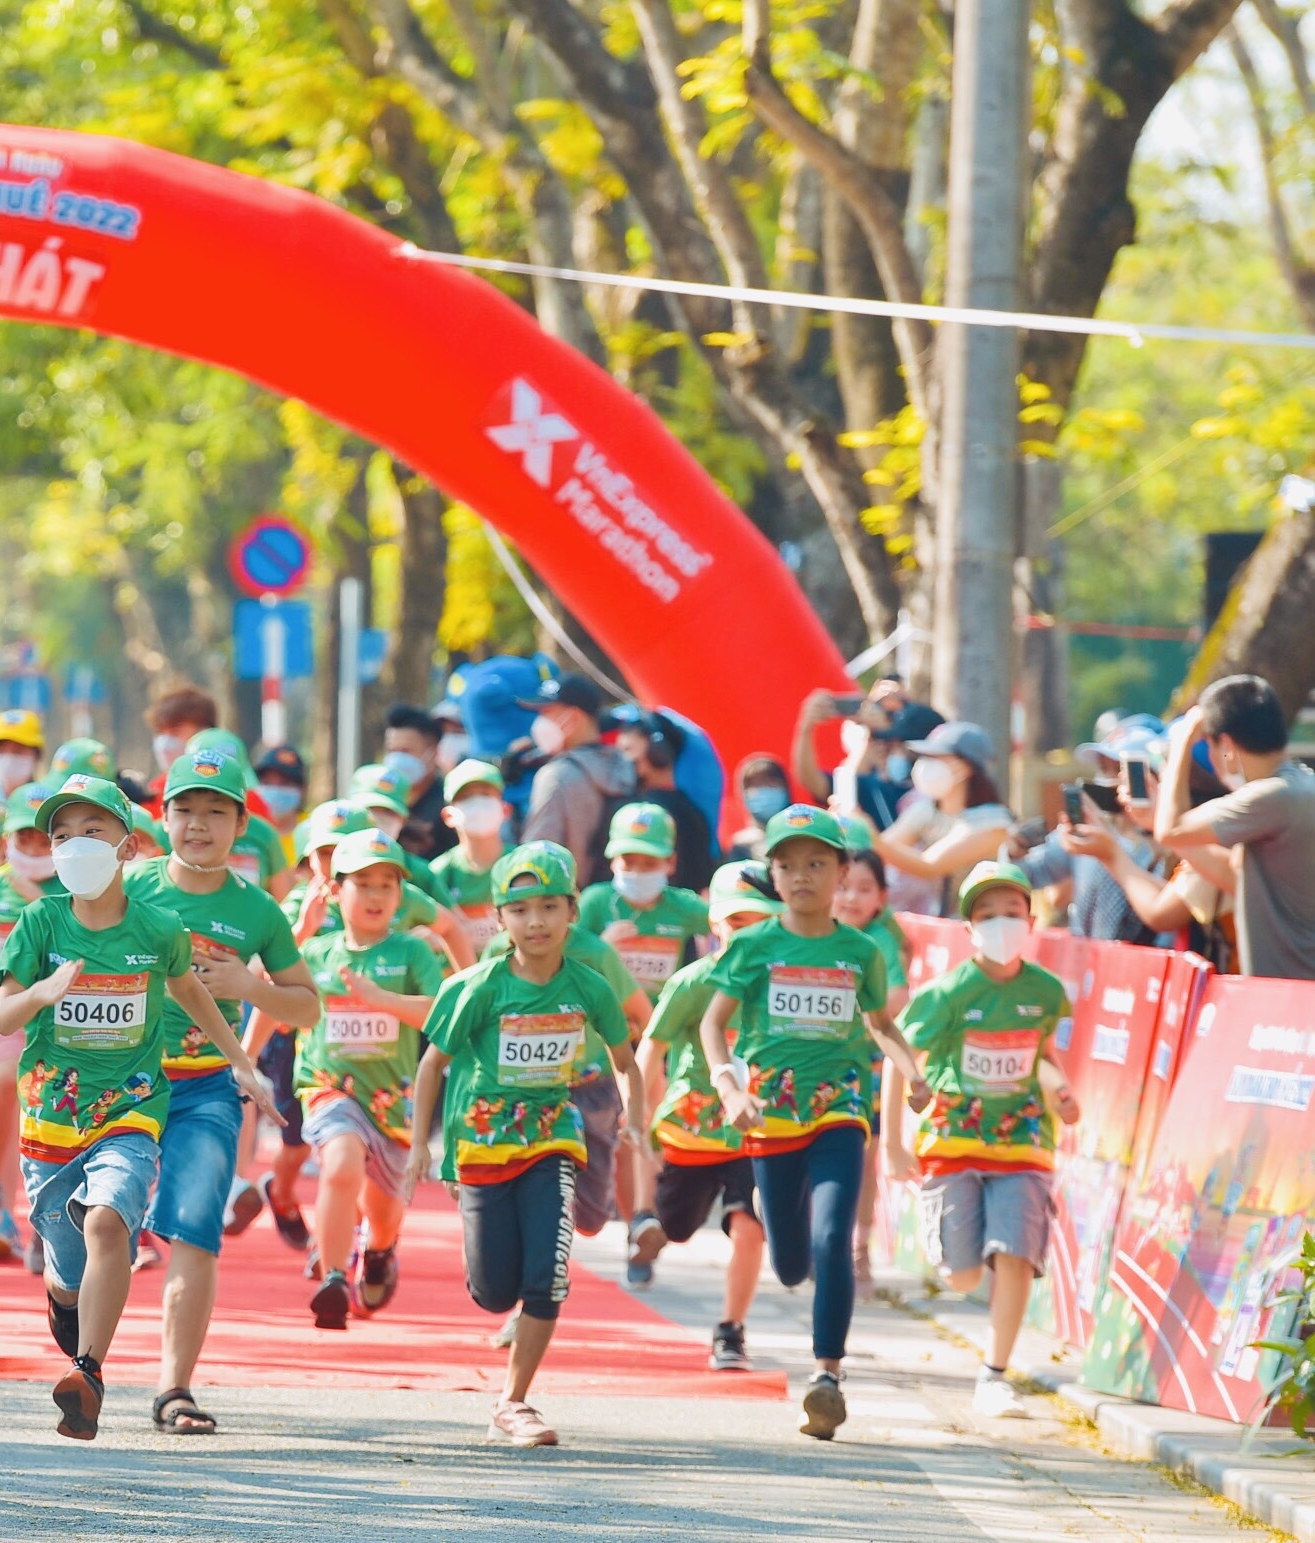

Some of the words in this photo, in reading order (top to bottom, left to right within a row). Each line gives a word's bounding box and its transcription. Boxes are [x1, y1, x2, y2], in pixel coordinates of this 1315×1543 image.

[53, 193, 138, 239] 2022
[555, 478, 680, 603] Marathon
[60, 1001, 135, 1024] 50406
[774, 992, 843, 1015] 50156
[332, 1019, 387, 1037] 50010
